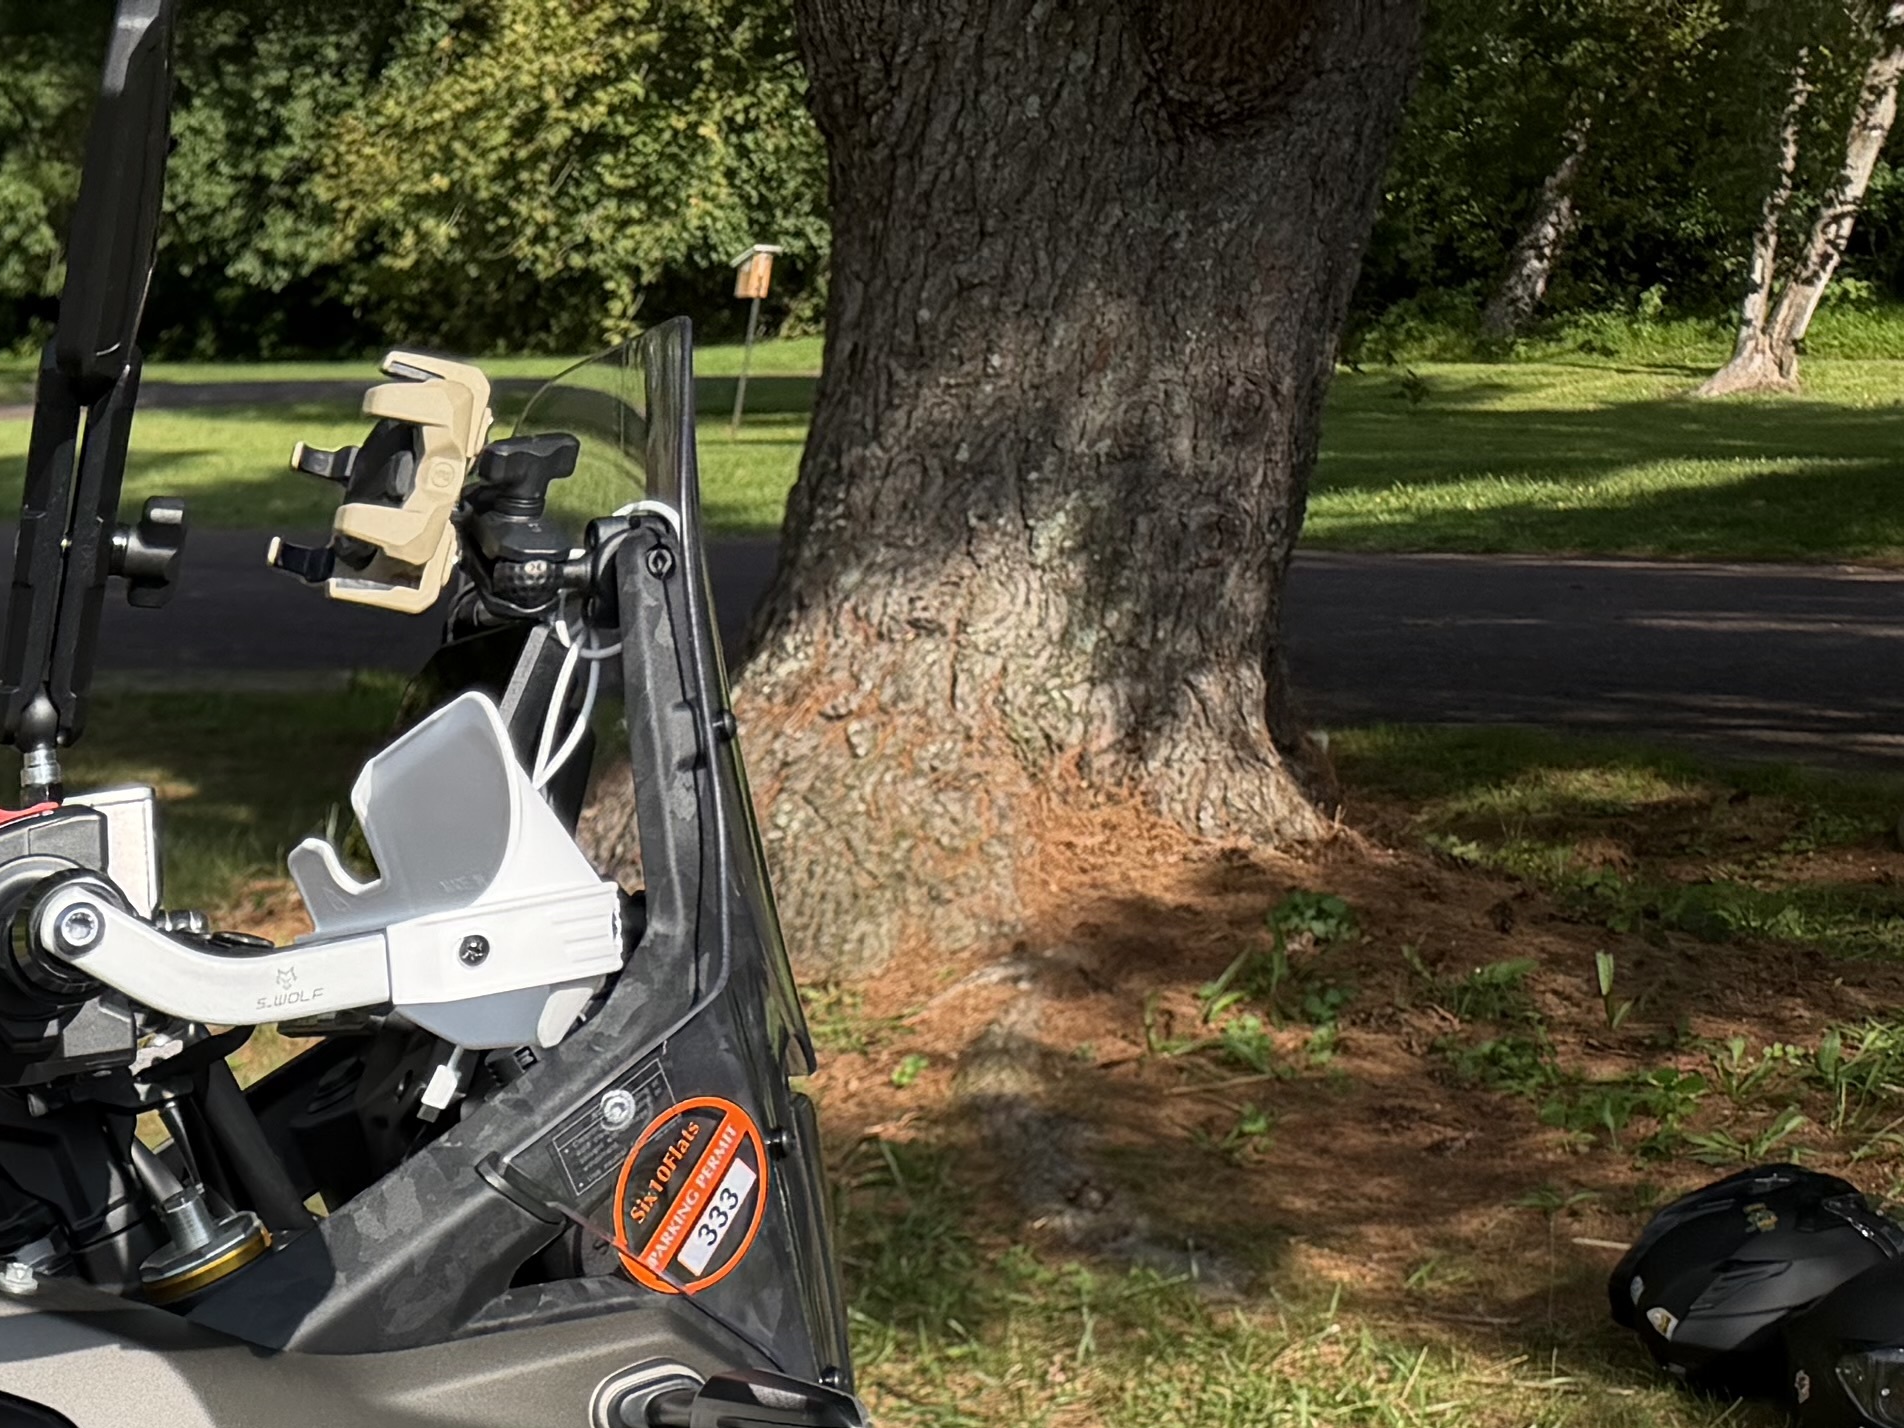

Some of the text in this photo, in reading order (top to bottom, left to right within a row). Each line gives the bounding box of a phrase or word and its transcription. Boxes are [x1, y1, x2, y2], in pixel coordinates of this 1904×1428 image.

[629, 1121, 701, 1223] Six10Flats
[647, 1124, 739, 1267] PARKING PERMIT
[697, 1188, 740, 1246] 333
